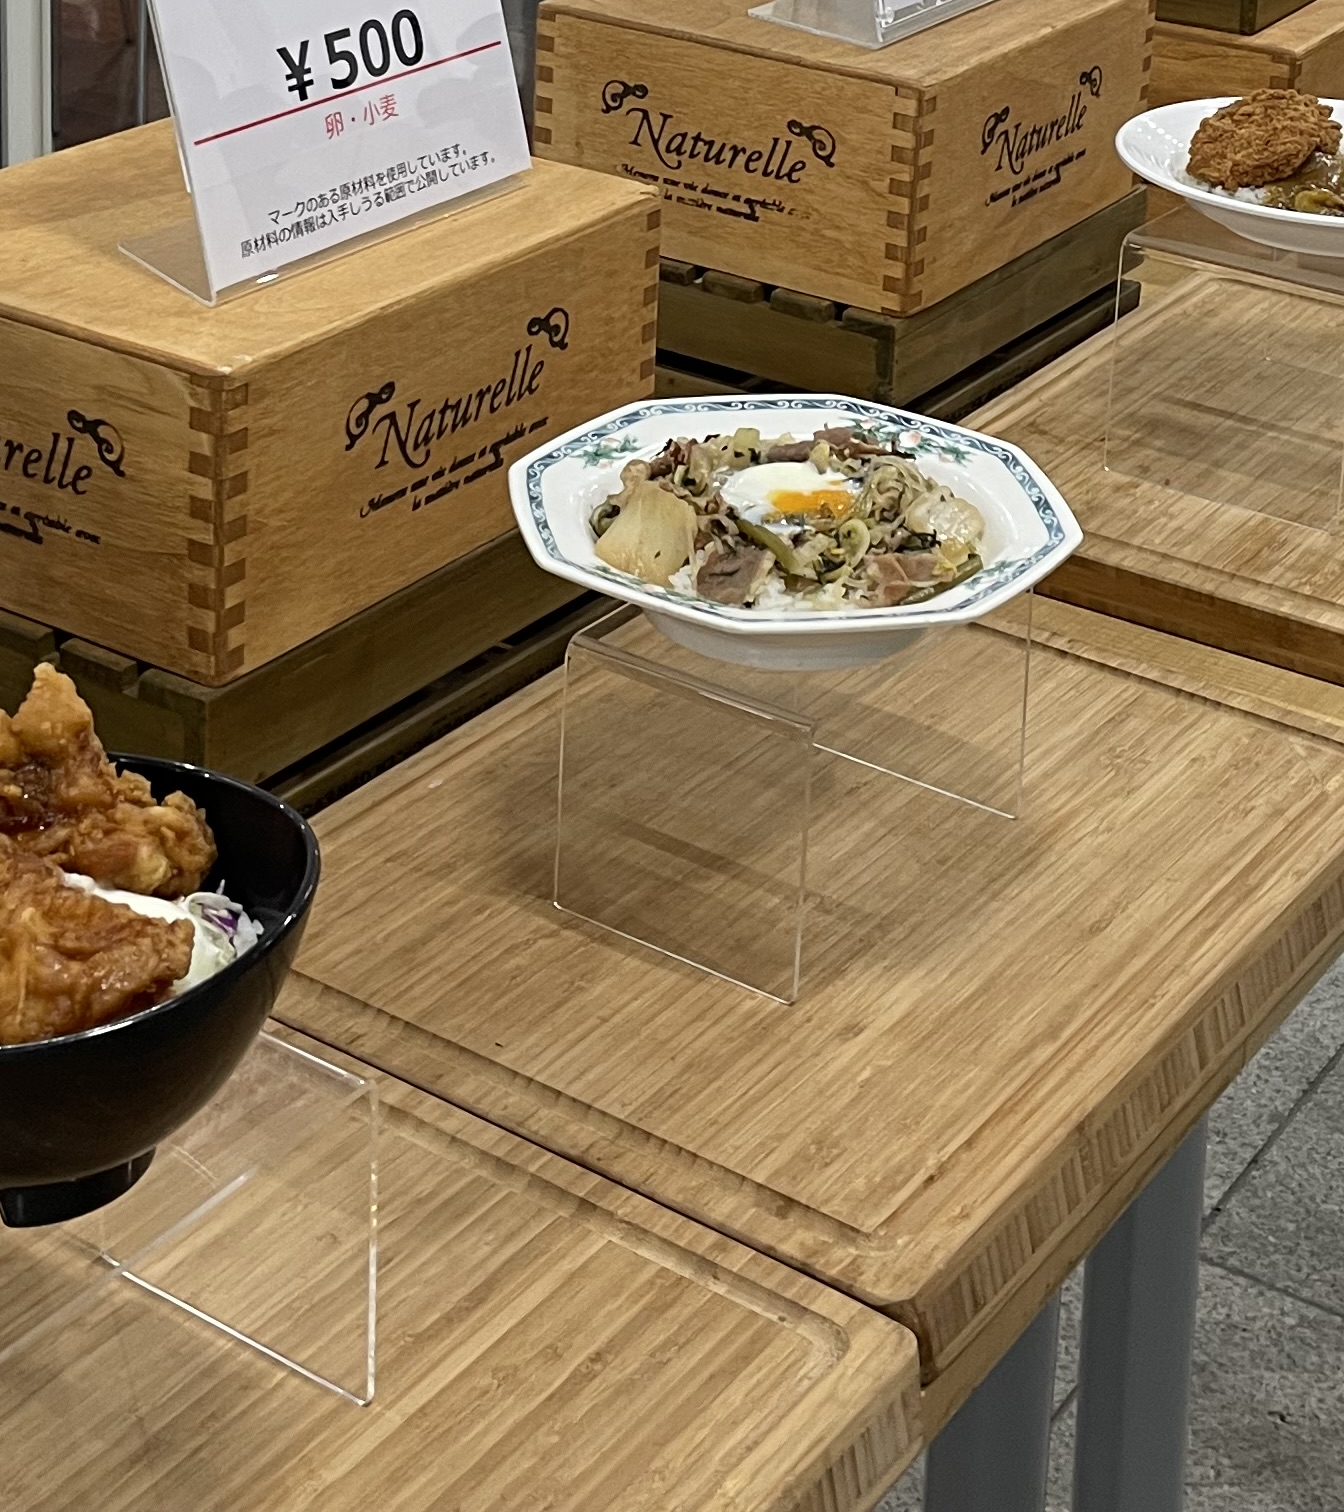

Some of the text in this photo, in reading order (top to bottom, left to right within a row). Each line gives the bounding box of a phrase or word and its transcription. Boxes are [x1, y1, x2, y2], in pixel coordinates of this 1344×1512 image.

[276, 9, 424, 102] ¥500
[324, 94, 400, 140] 卵・小麦
[625, 106, 808, 185] Naturelle
[994, 90, 1087, 175] Naturelle
[240, 152, 497, 259] 原材料の情報は入手しうる範囲で公開しています。
[268, 143, 468, 226] マークのある原材料を使用しています。
[373, 343, 546, 470] Naturelle
